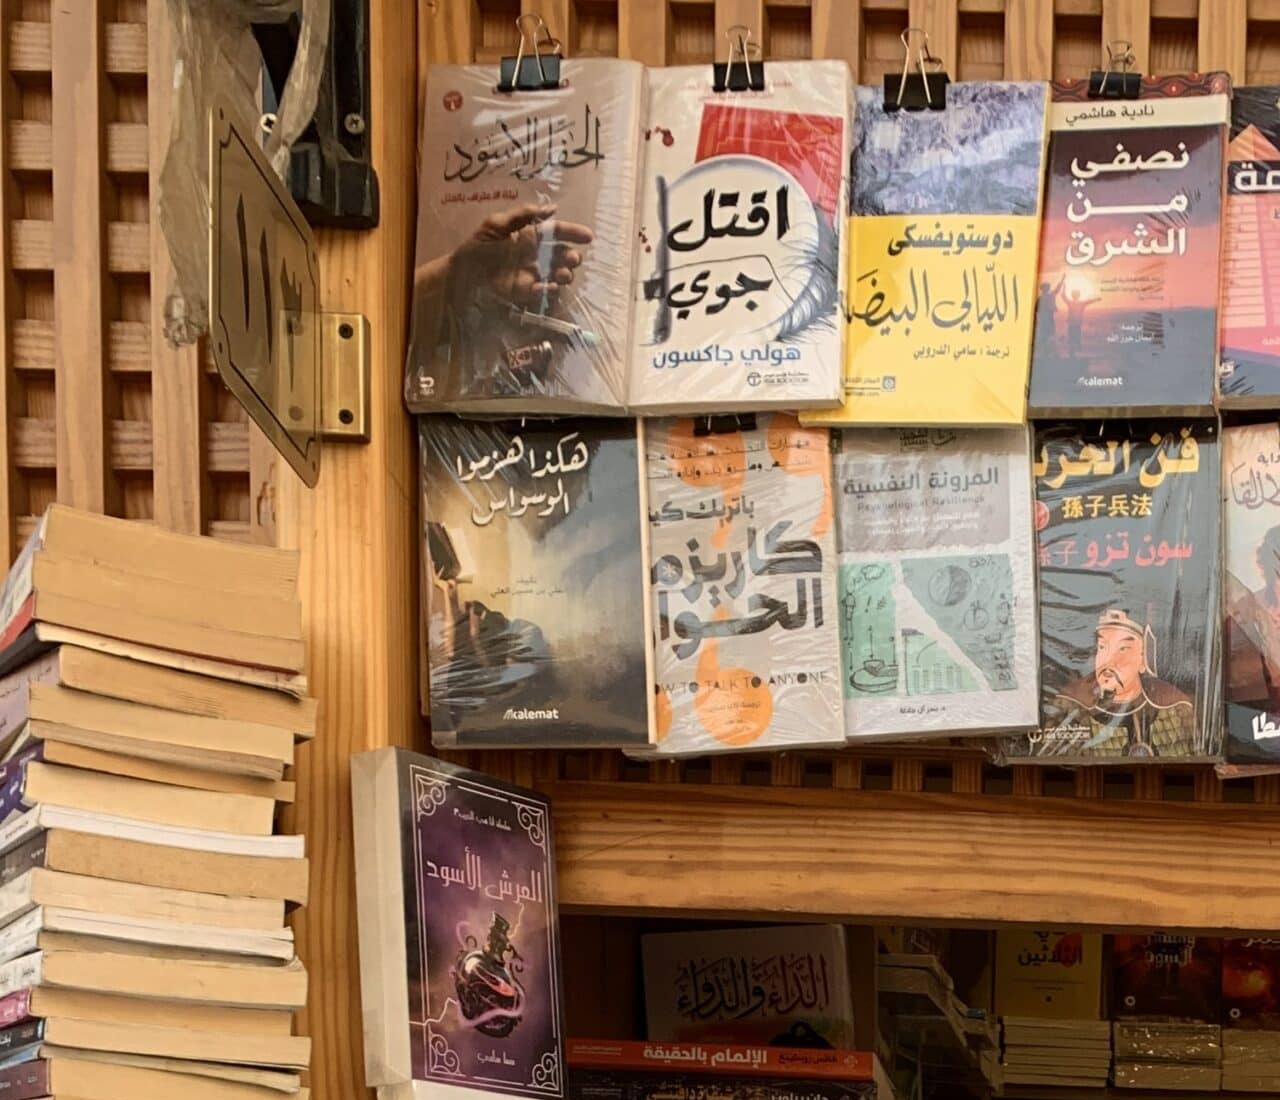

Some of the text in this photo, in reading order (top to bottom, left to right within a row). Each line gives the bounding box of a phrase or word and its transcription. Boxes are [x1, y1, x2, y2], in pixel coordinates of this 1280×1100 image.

[1069, 142, 1190, 187] نصفي
[667, 184, 791, 252] اقتل
[1066, 189, 1188, 223] من
[1064, 222, 1187, 267] الشرق
[667, 270, 774, 320] جوي
[456, 431, 589, 483] هكذا هزموا
[1139, 428, 1201, 489] فن
[471, 478, 570, 526] الوسواس
[843, 466, 999, 499] المرونة النفسية
[1061, 494, 1153, 519] 孫子兵法
[1134, 533, 1193, 567] سون
